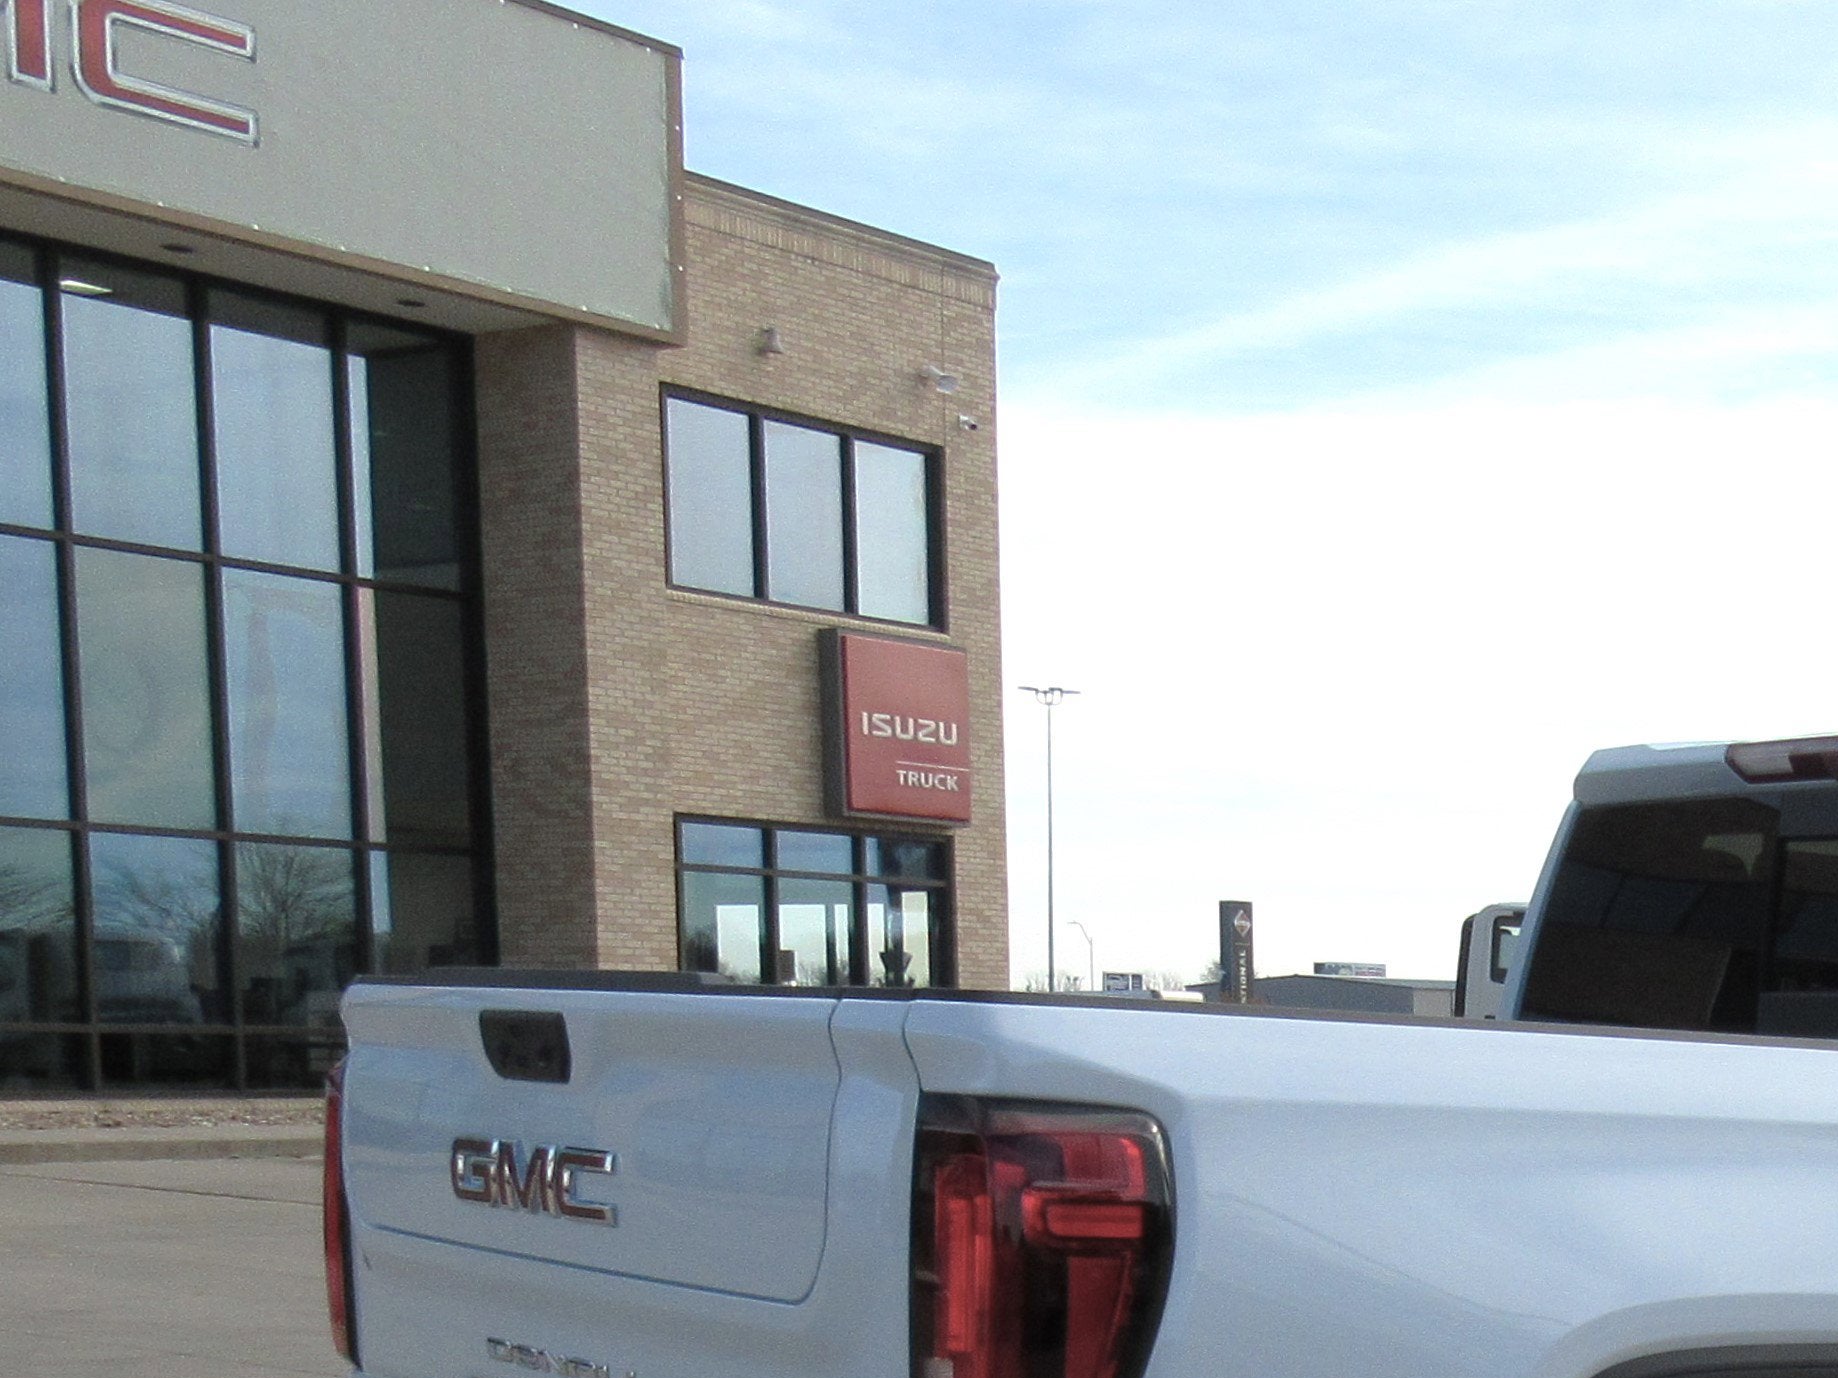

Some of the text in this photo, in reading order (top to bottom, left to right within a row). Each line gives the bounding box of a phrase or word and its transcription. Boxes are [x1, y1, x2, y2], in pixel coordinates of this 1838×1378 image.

[861, 711, 958, 746] ISUZU
[896, 769, 958, 791] TRUCK
[451, 1137, 618, 1227] GMC
